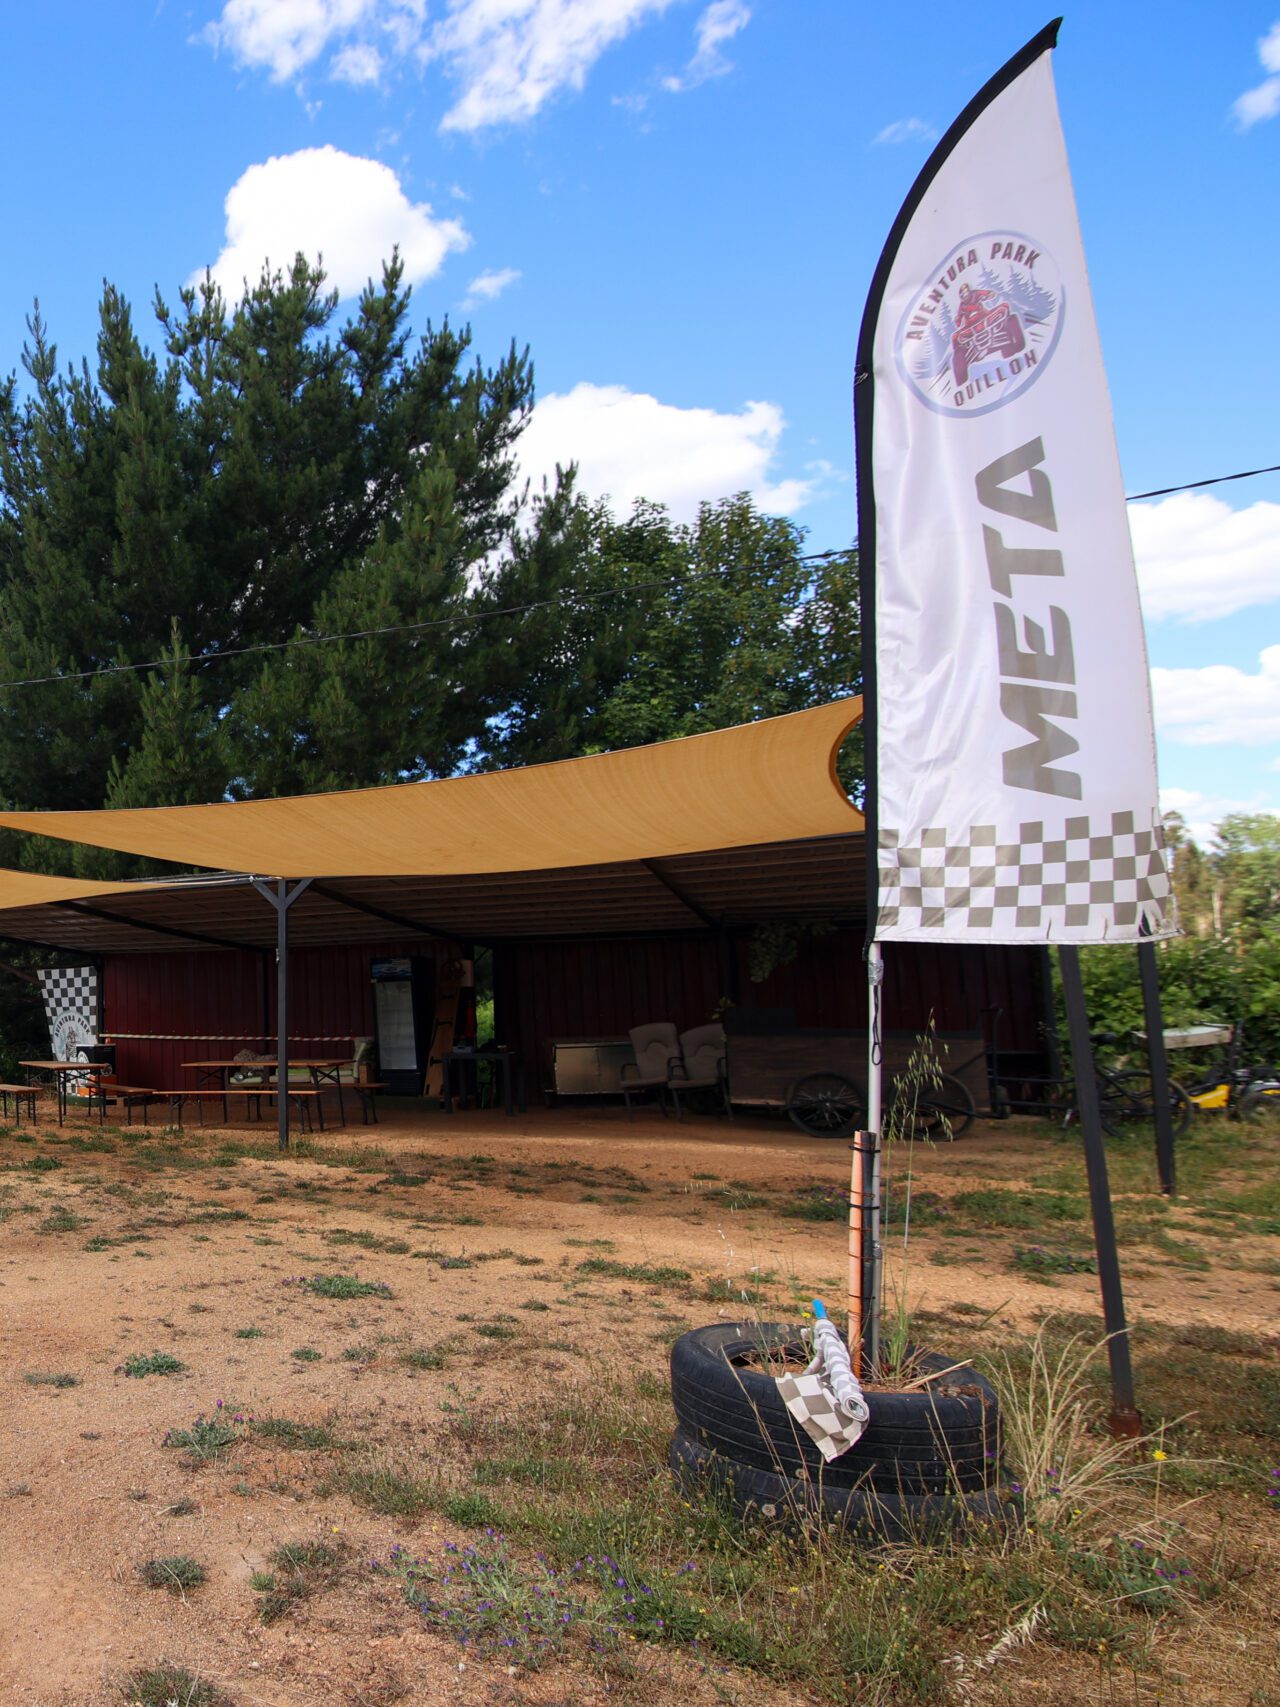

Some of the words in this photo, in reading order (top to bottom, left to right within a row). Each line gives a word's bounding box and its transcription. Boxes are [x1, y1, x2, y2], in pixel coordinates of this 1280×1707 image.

[906, 248, 979, 341] AVENTURA
[990, 242, 1040, 270] PARK
[975, 436, 1082, 800] META
